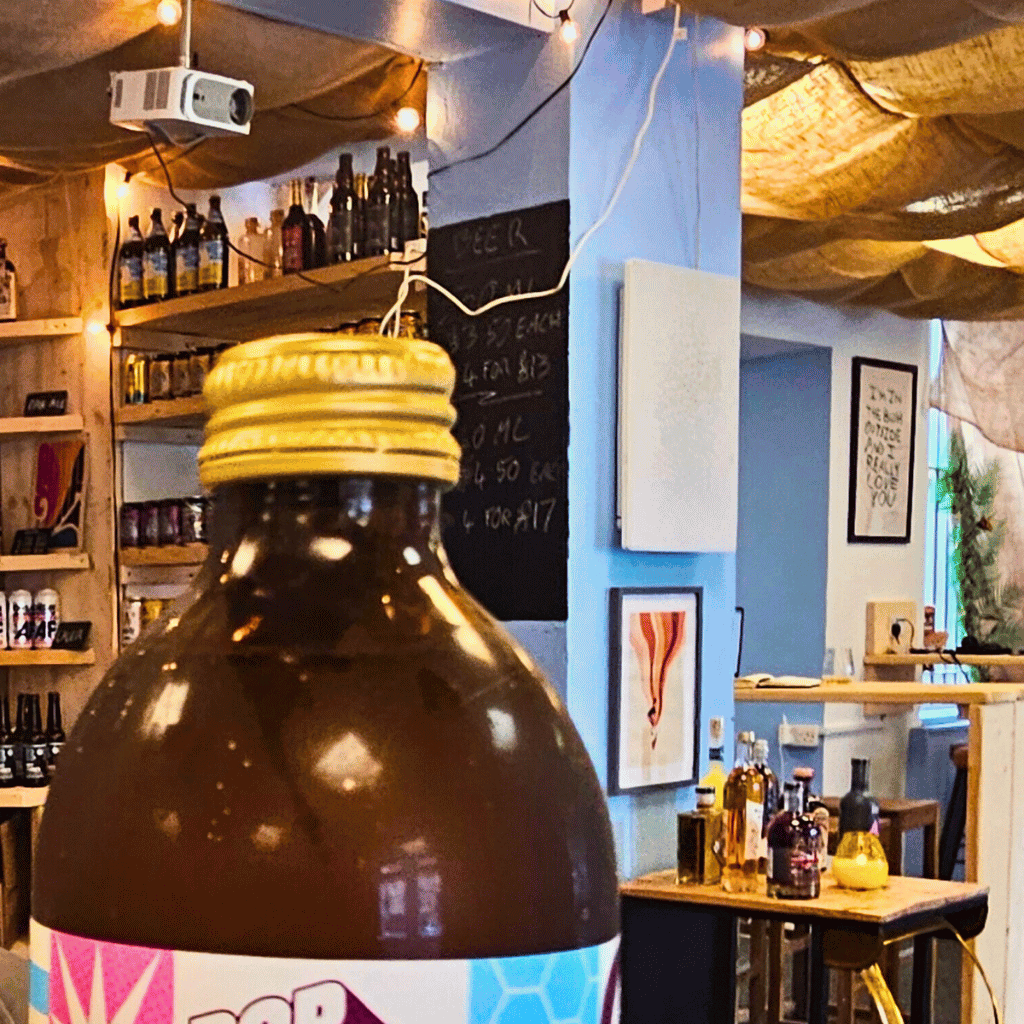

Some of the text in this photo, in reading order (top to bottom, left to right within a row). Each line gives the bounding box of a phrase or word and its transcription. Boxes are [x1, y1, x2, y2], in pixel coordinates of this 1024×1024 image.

[495, 454, 521, 484] 50
[866, 473, 899, 490] LOVE
[870, 491, 897, 508] YOU
[484, 506, 512, 529] FOR
[35, 620, 57, 640] AF
